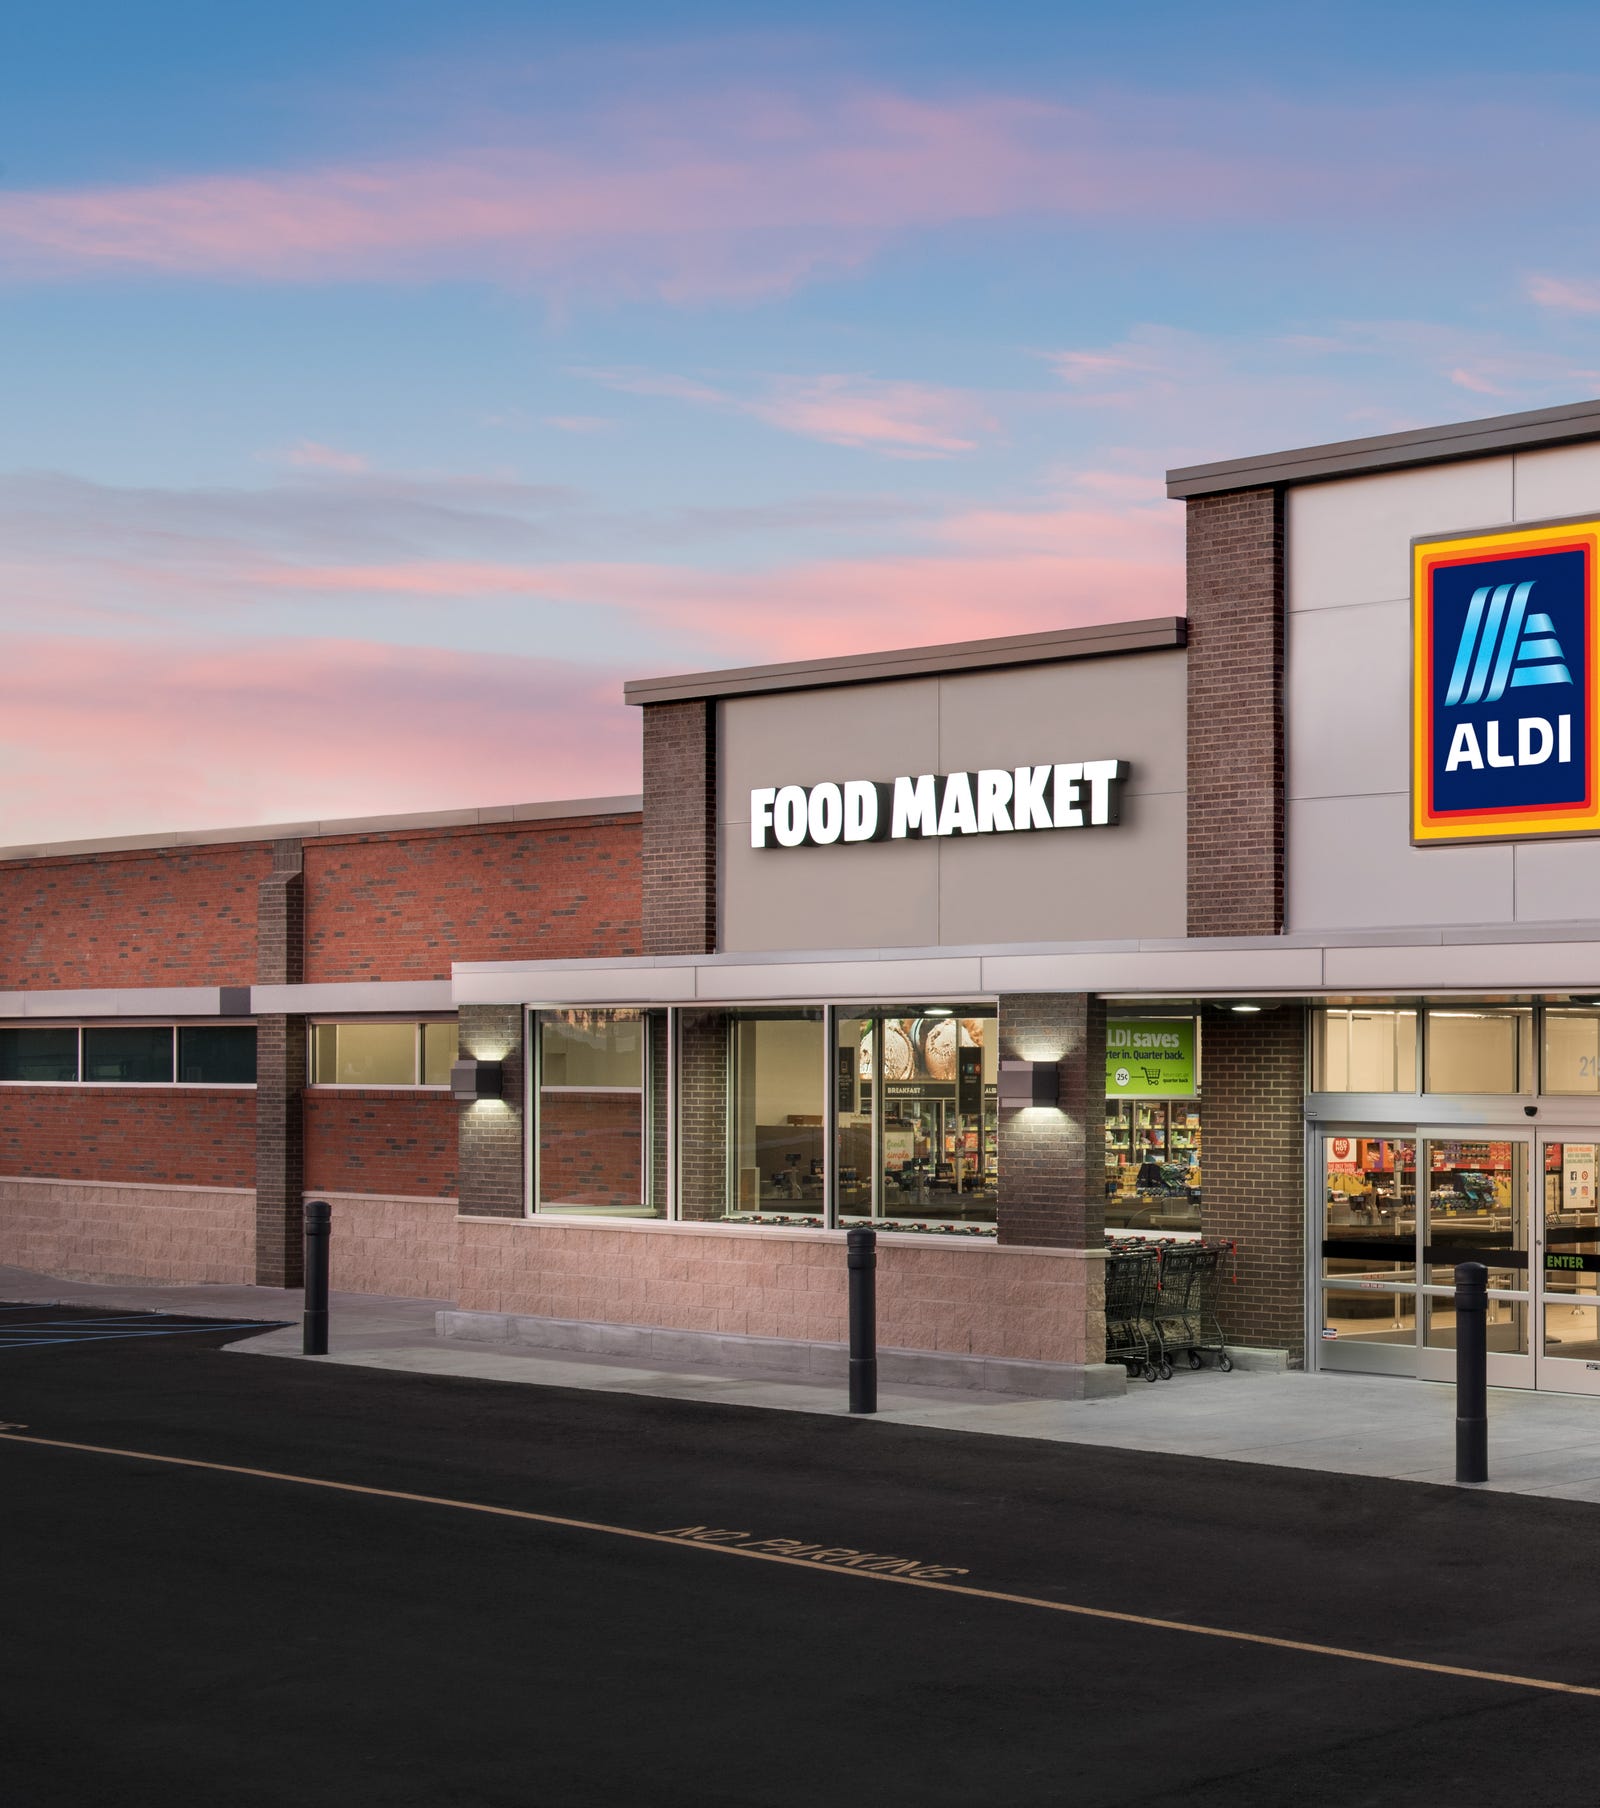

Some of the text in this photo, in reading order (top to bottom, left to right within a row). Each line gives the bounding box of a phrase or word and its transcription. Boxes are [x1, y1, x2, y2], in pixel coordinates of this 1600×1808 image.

[1445, 714, 1572, 772] ALDI
[751, 759, 1120, 849] FOOD MARKET
[1106, 1029, 1180, 1048] LDI saves
[1106, 1050, 1120, 1059] rter
[1122, 1049, 1132, 1059] in.
[1133, 1051, 1163, 1060] Quarter
[1116, 1073, 1128, 1081] 25¢
[1547, 1255, 1584, 1269] ENTER
[656, 1526, 970, 1578] NO PARKING
